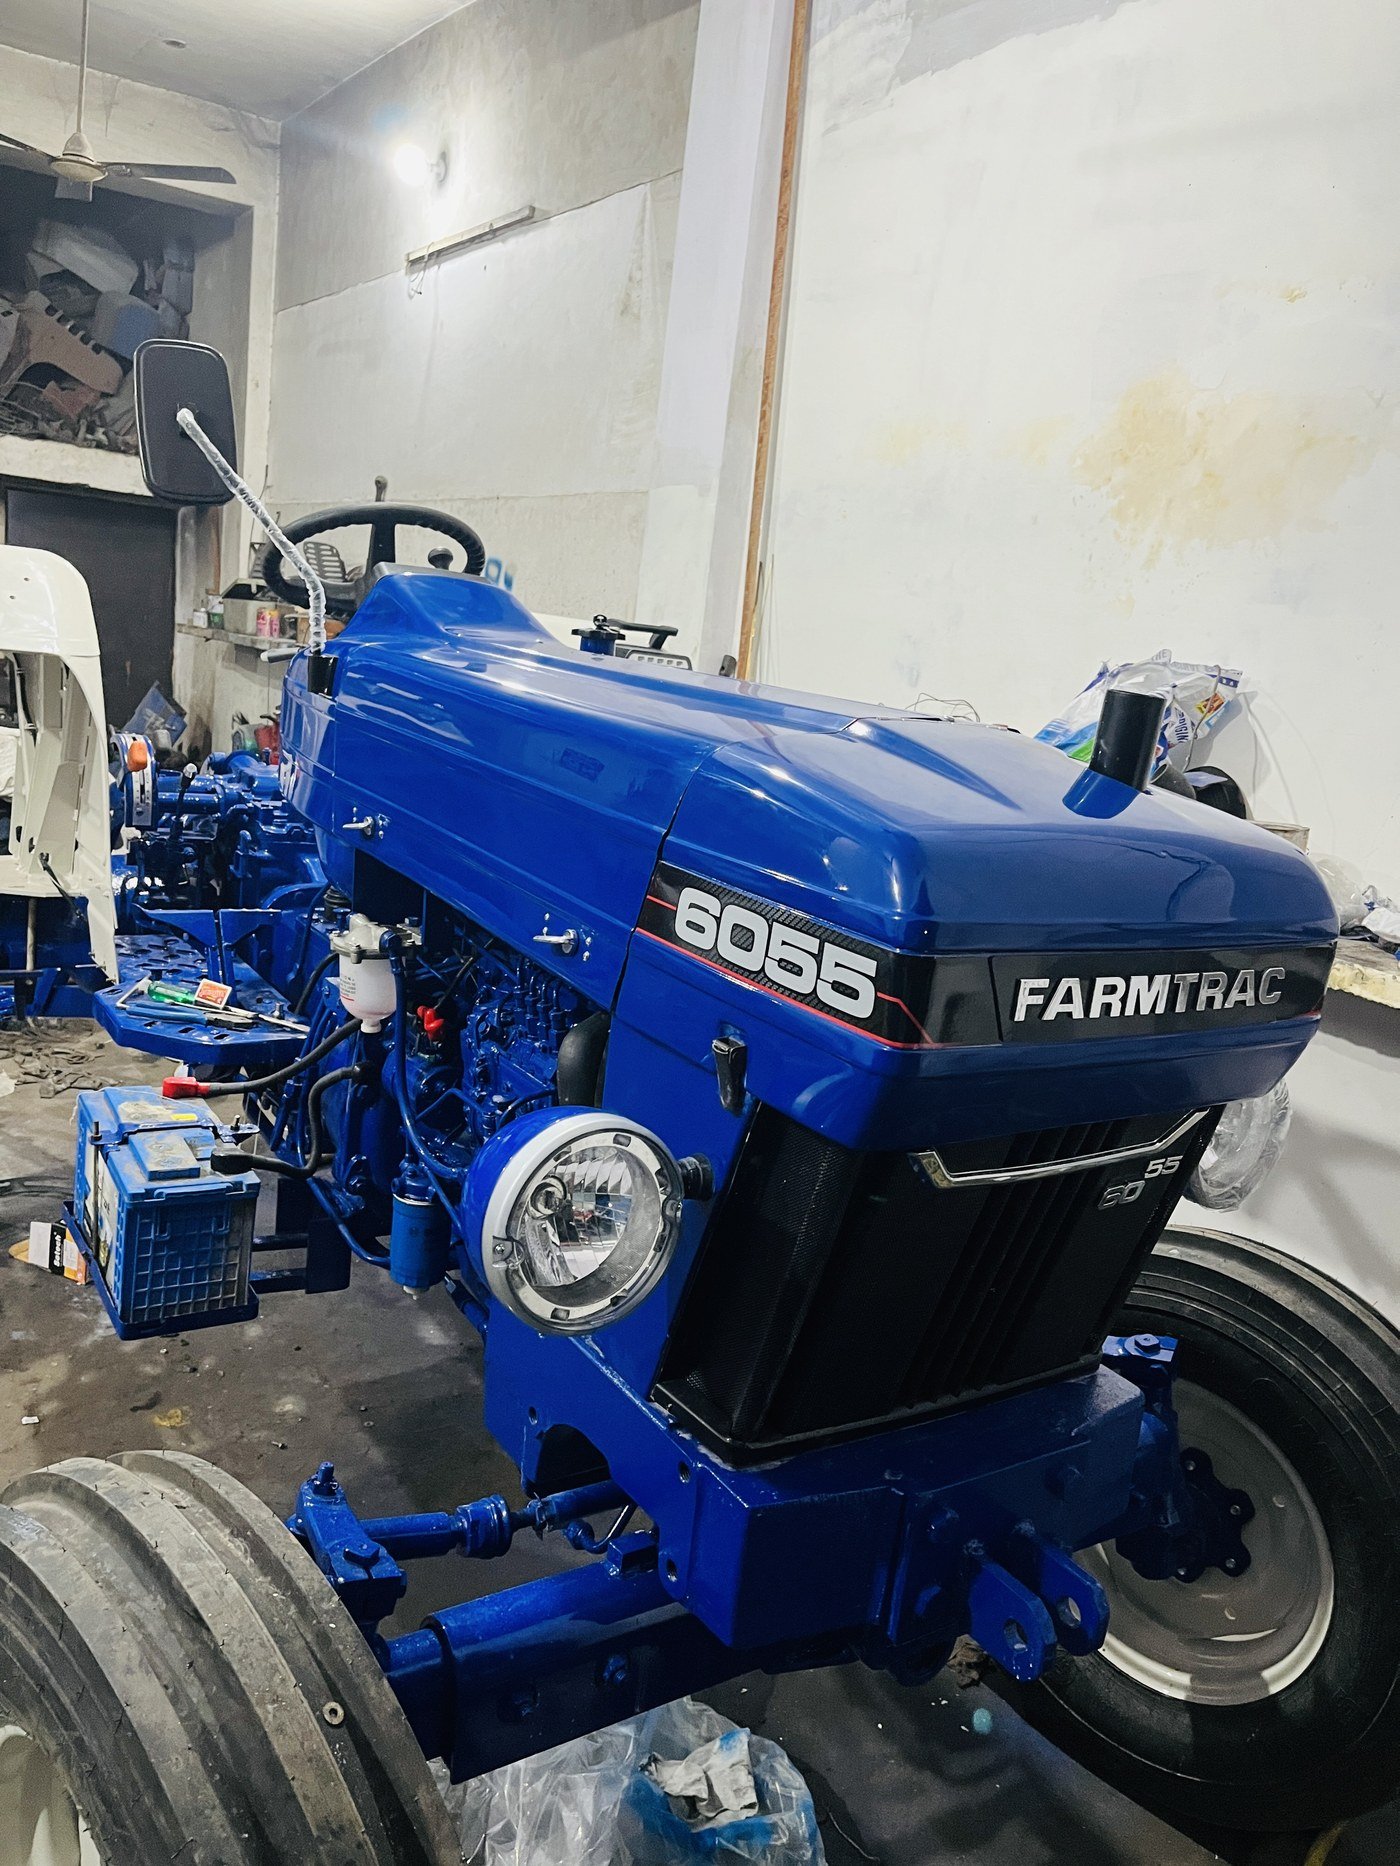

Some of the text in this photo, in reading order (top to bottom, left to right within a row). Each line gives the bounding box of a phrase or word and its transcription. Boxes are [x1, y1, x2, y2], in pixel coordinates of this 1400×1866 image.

[675, 886, 877, 1019] 6055
[1014, 967, 1285, 1022] FARMTRAC
[1098, 1155, 1183, 1210] 60 55
